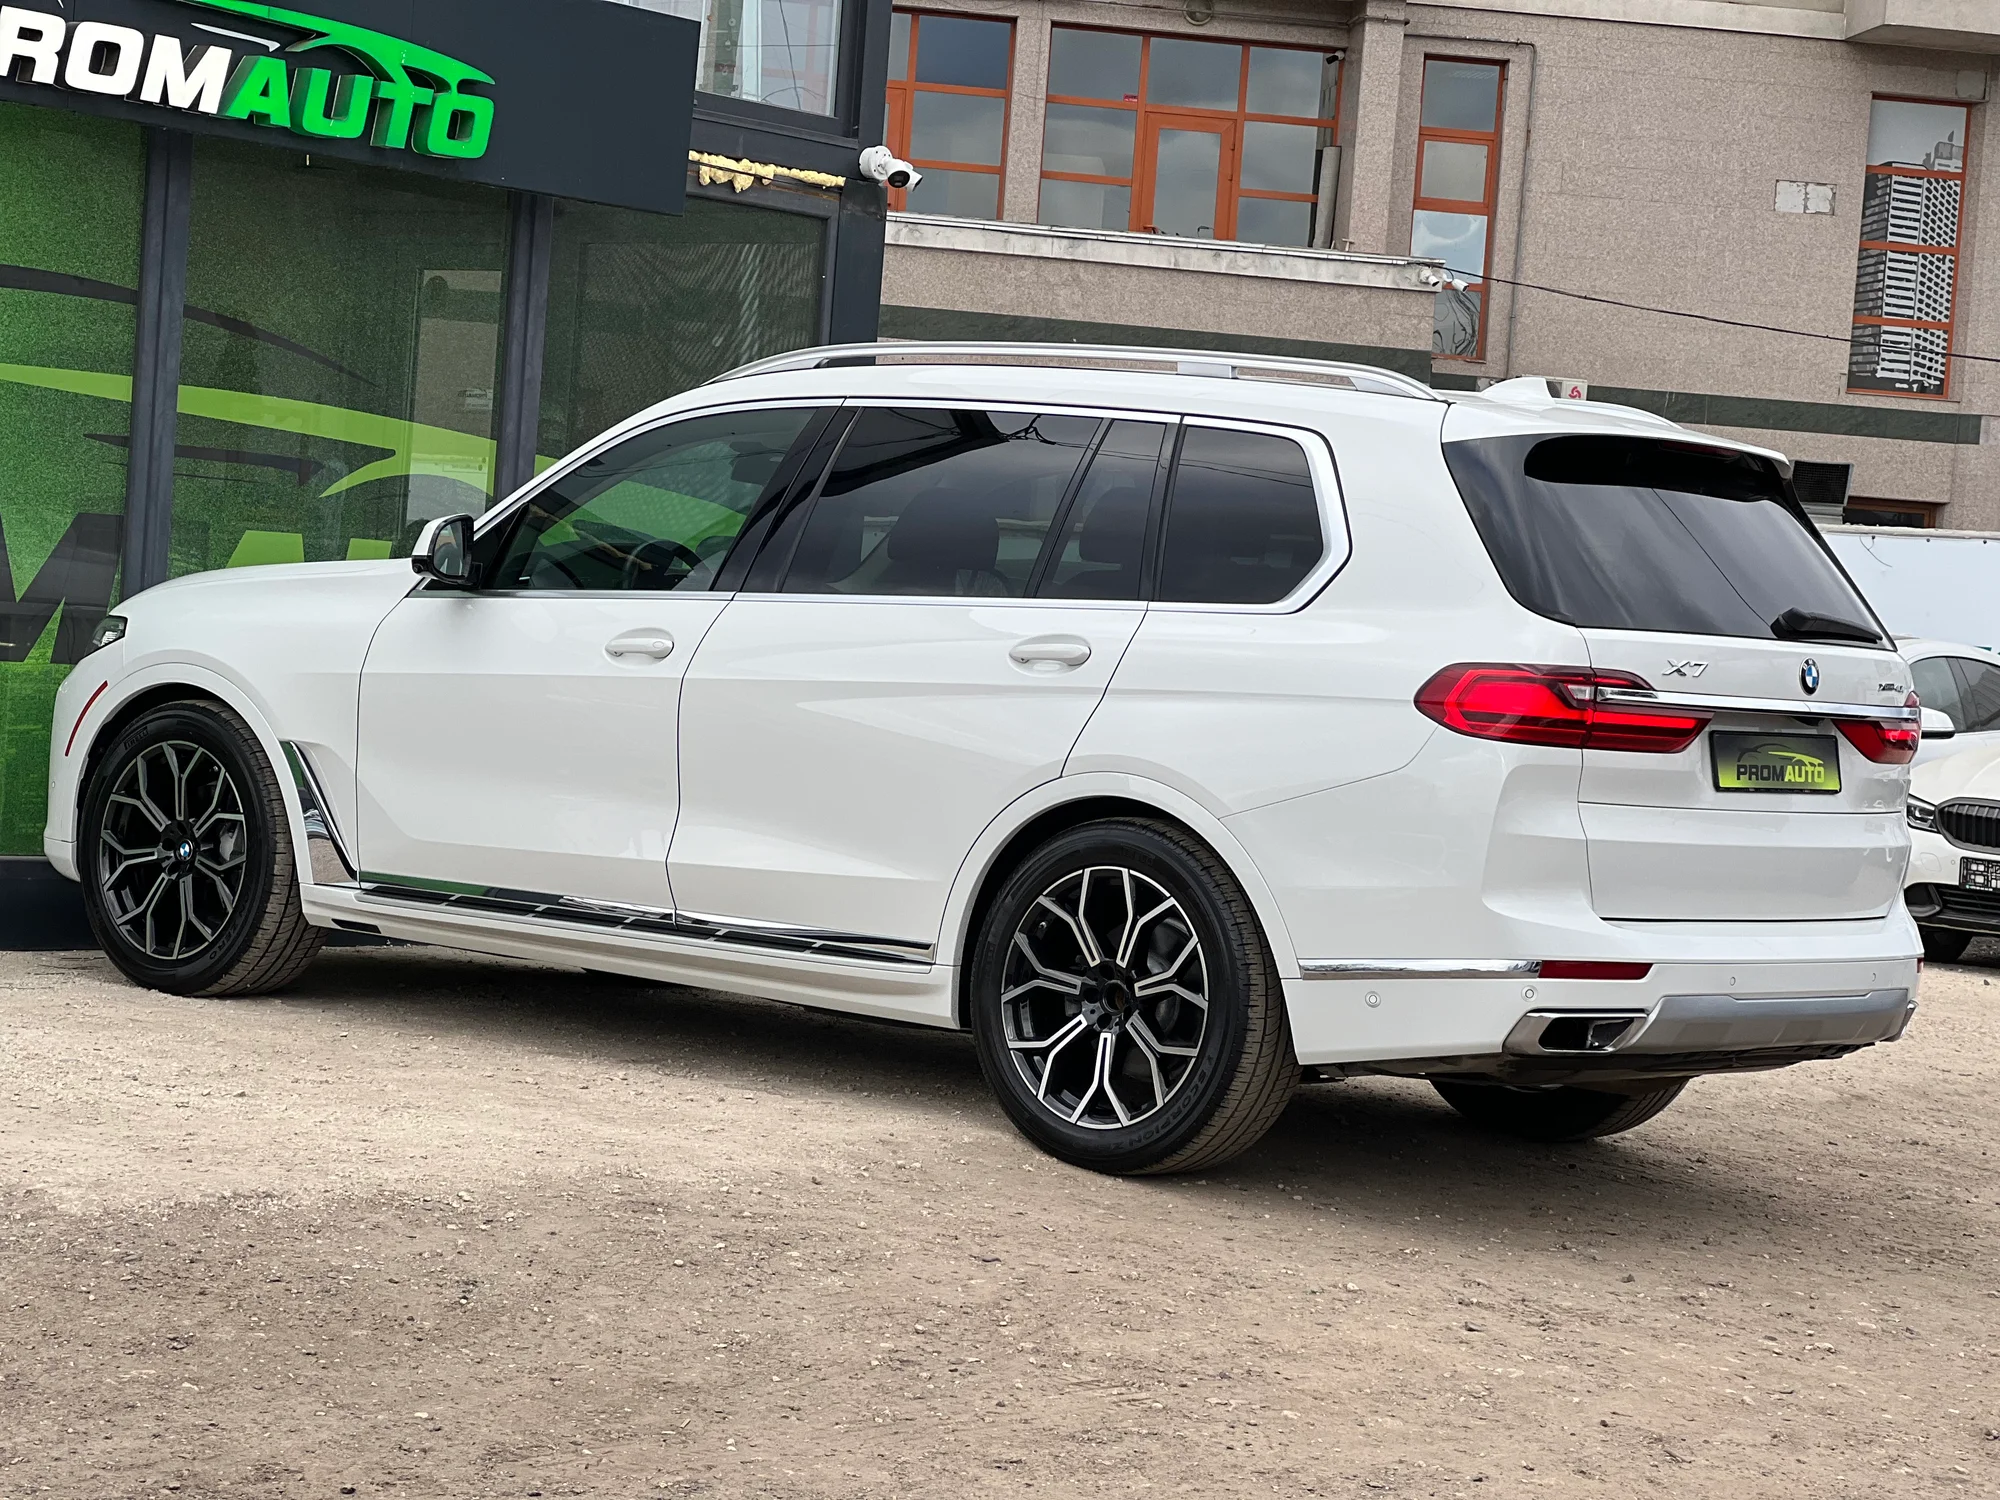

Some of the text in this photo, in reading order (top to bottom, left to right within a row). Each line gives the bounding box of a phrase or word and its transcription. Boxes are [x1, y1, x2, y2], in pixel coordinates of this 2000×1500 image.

[1661, 659, 1709, 678] X7
[1736, 764, 1825, 783] PROMAUTO
[1129, 1069, 1207, 1147] SCORPION
